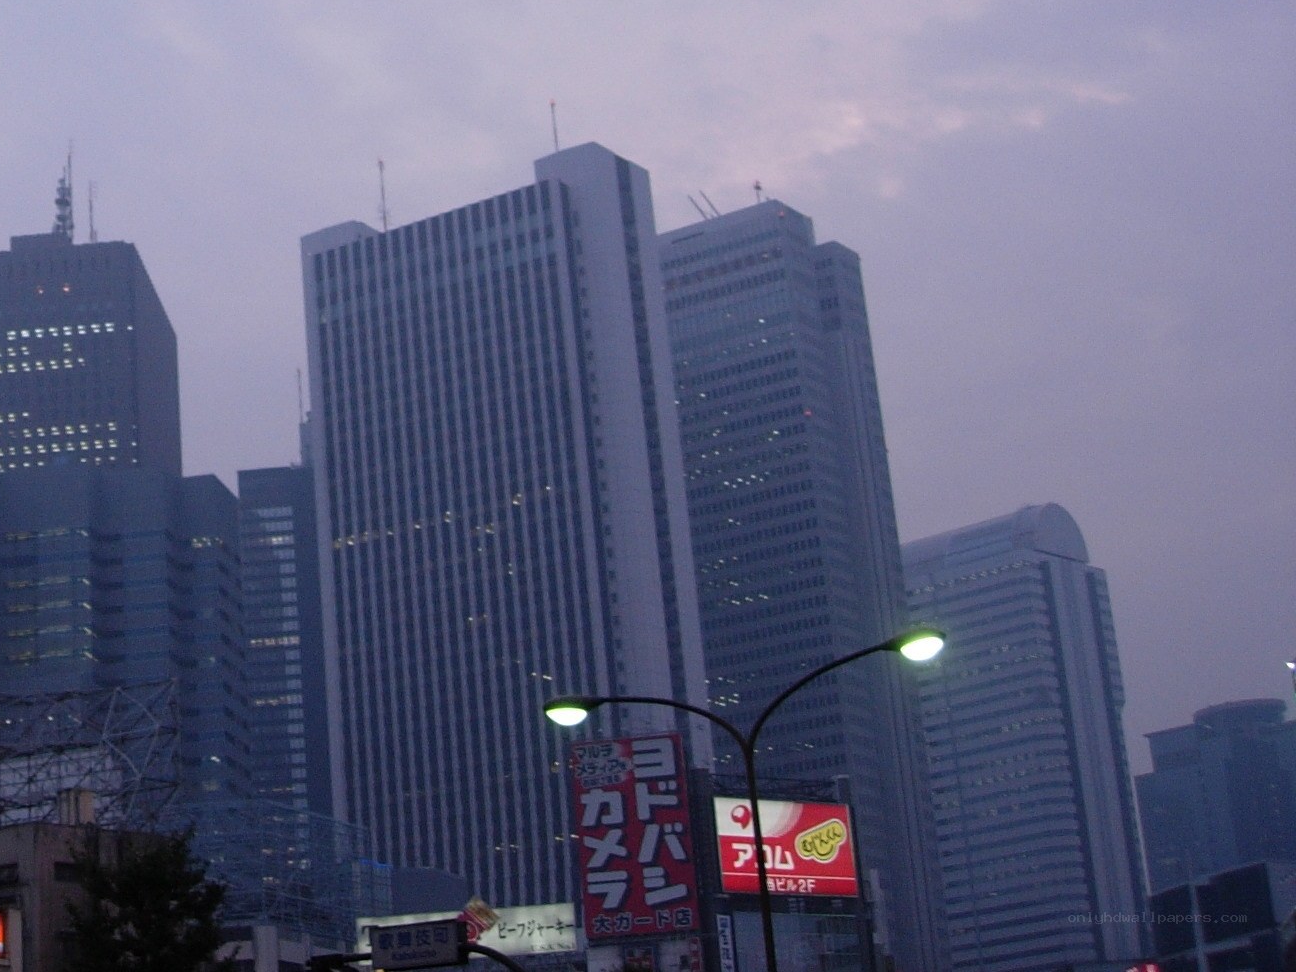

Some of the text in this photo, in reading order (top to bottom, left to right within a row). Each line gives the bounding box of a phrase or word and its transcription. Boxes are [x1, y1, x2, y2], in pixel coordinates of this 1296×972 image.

[631, 737, 688, 906] ヨドバシ
[580, 789, 628, 910] カメラ
[731, 841, 795, 870] アコム
[498, 917, 574, 939] ビーフジャーキー
[592, 907, 693, 934] 大ガード店
